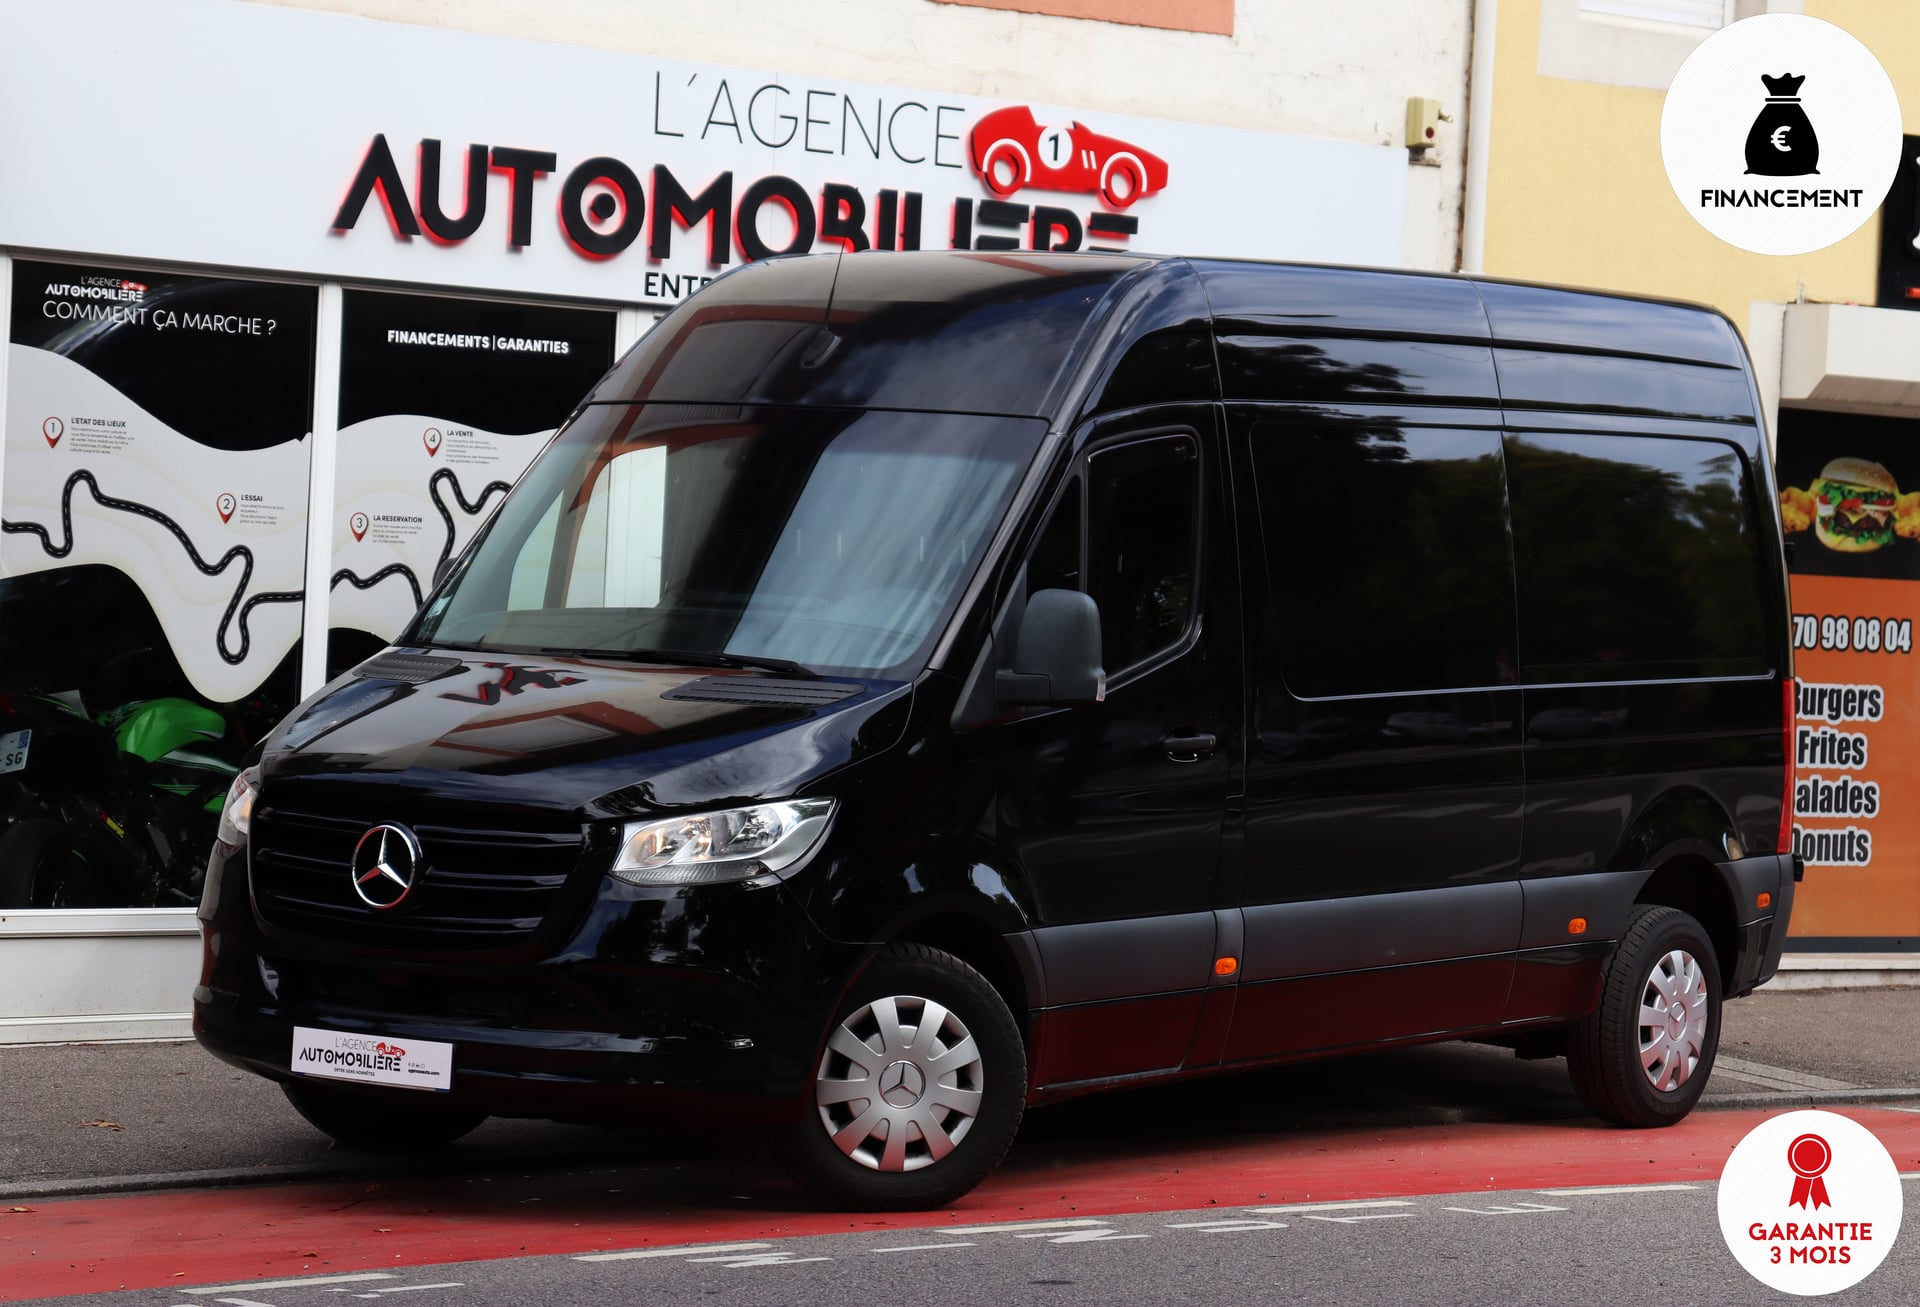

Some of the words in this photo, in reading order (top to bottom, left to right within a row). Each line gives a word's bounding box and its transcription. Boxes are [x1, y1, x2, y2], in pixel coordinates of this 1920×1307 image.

[654, 71, 967, 169] L'AGENCE
[644, 271, 714, 299] ENT
[42, 300, 149, 326] COMMENT
[152, 309, 178, 331] ÇA
[183, 312, 262, 335] MARCHE
[387, 330, 490, 349] FINANCEMENTS
[496, 336, 569, 354] GARANTIES
[92, 418, 106, 427] DES
[107, 420, 127, 428] LIEUX
[446, 429, 455, 437] LA
[455, 430, 474, 438] VENTE
[429, 433, 436, 443] 4
[223, 497, 230, 510] 2
[356, 517, 363, 529] 3
[382, 515, 423, 523] RESERVATION
[1792, 615, 1818, 649] 70
[1820, 616, 1850, 650] 98
[1852, 617, 1881, 652] 08
[1884, 619, 1912, 653] 04
[1797, 730, 1866, 766] Frites
[1795, 778, 1877, 814] alades
